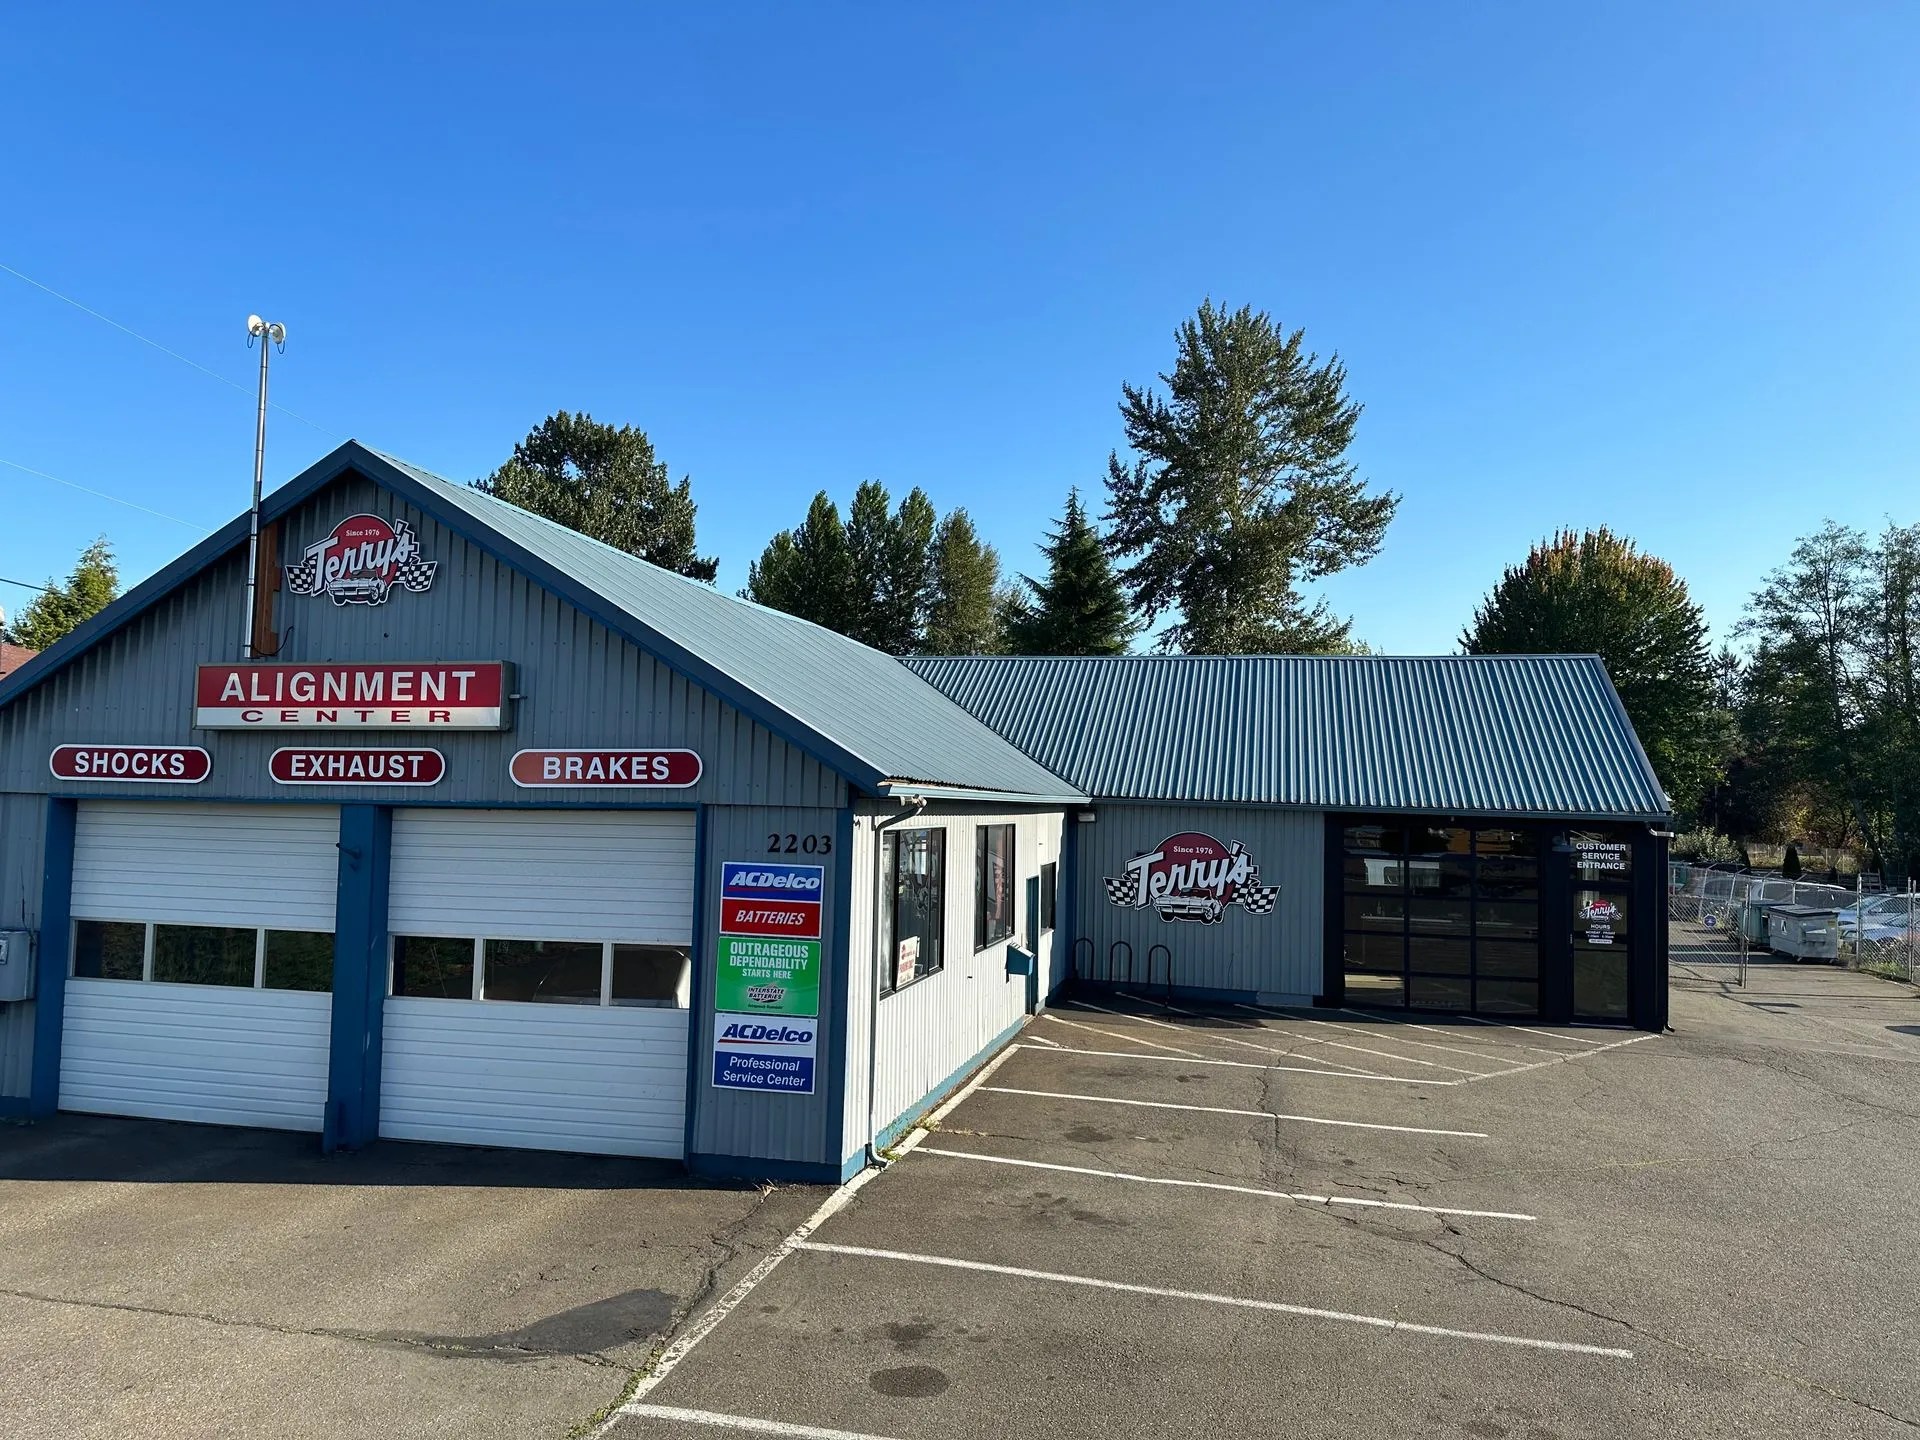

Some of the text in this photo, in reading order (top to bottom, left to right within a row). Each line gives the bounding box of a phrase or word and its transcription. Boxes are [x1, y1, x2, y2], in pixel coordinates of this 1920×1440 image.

[345, 529, 363, 537] Since
[306, 523, 415, 592] Terry's
[220, 671, 476, 702] ALIGNMENT
[241, 710, 453, 723] CENTER
[74, 751, 185, 776] SHOCKS
[291, 754, 424, 778] EXHAUST
[543, 756, 670, 781] BRAKES
[767, 833, 833, 855] 2203
[1173, 845, 1213, 854] Since 1976
[1576, 842, 1626, 851] CUSTOMER
[1581, 852, 1620, 860] SERVICE
[1576, 861, 1626, 870] ENTRANCE
[729, 871, 820, 889] ACDelco
[1127, 842, 1254, 907] Terry's
[735, 910, 806, 925] BATTERIES
[1584, 902, 1616, 918] Terry's
[730, 941, 809, 958] OUTRAGEOUS
[729, 955, 808, 970] DEPENDABILITY
[742, 968, 792, 979] STARTS HERE
[722, 1023, 813, 1042] ACDelco
[729, 1056, 800, 1071] Professional
[722, 1070, 806, 1086] Service Center
